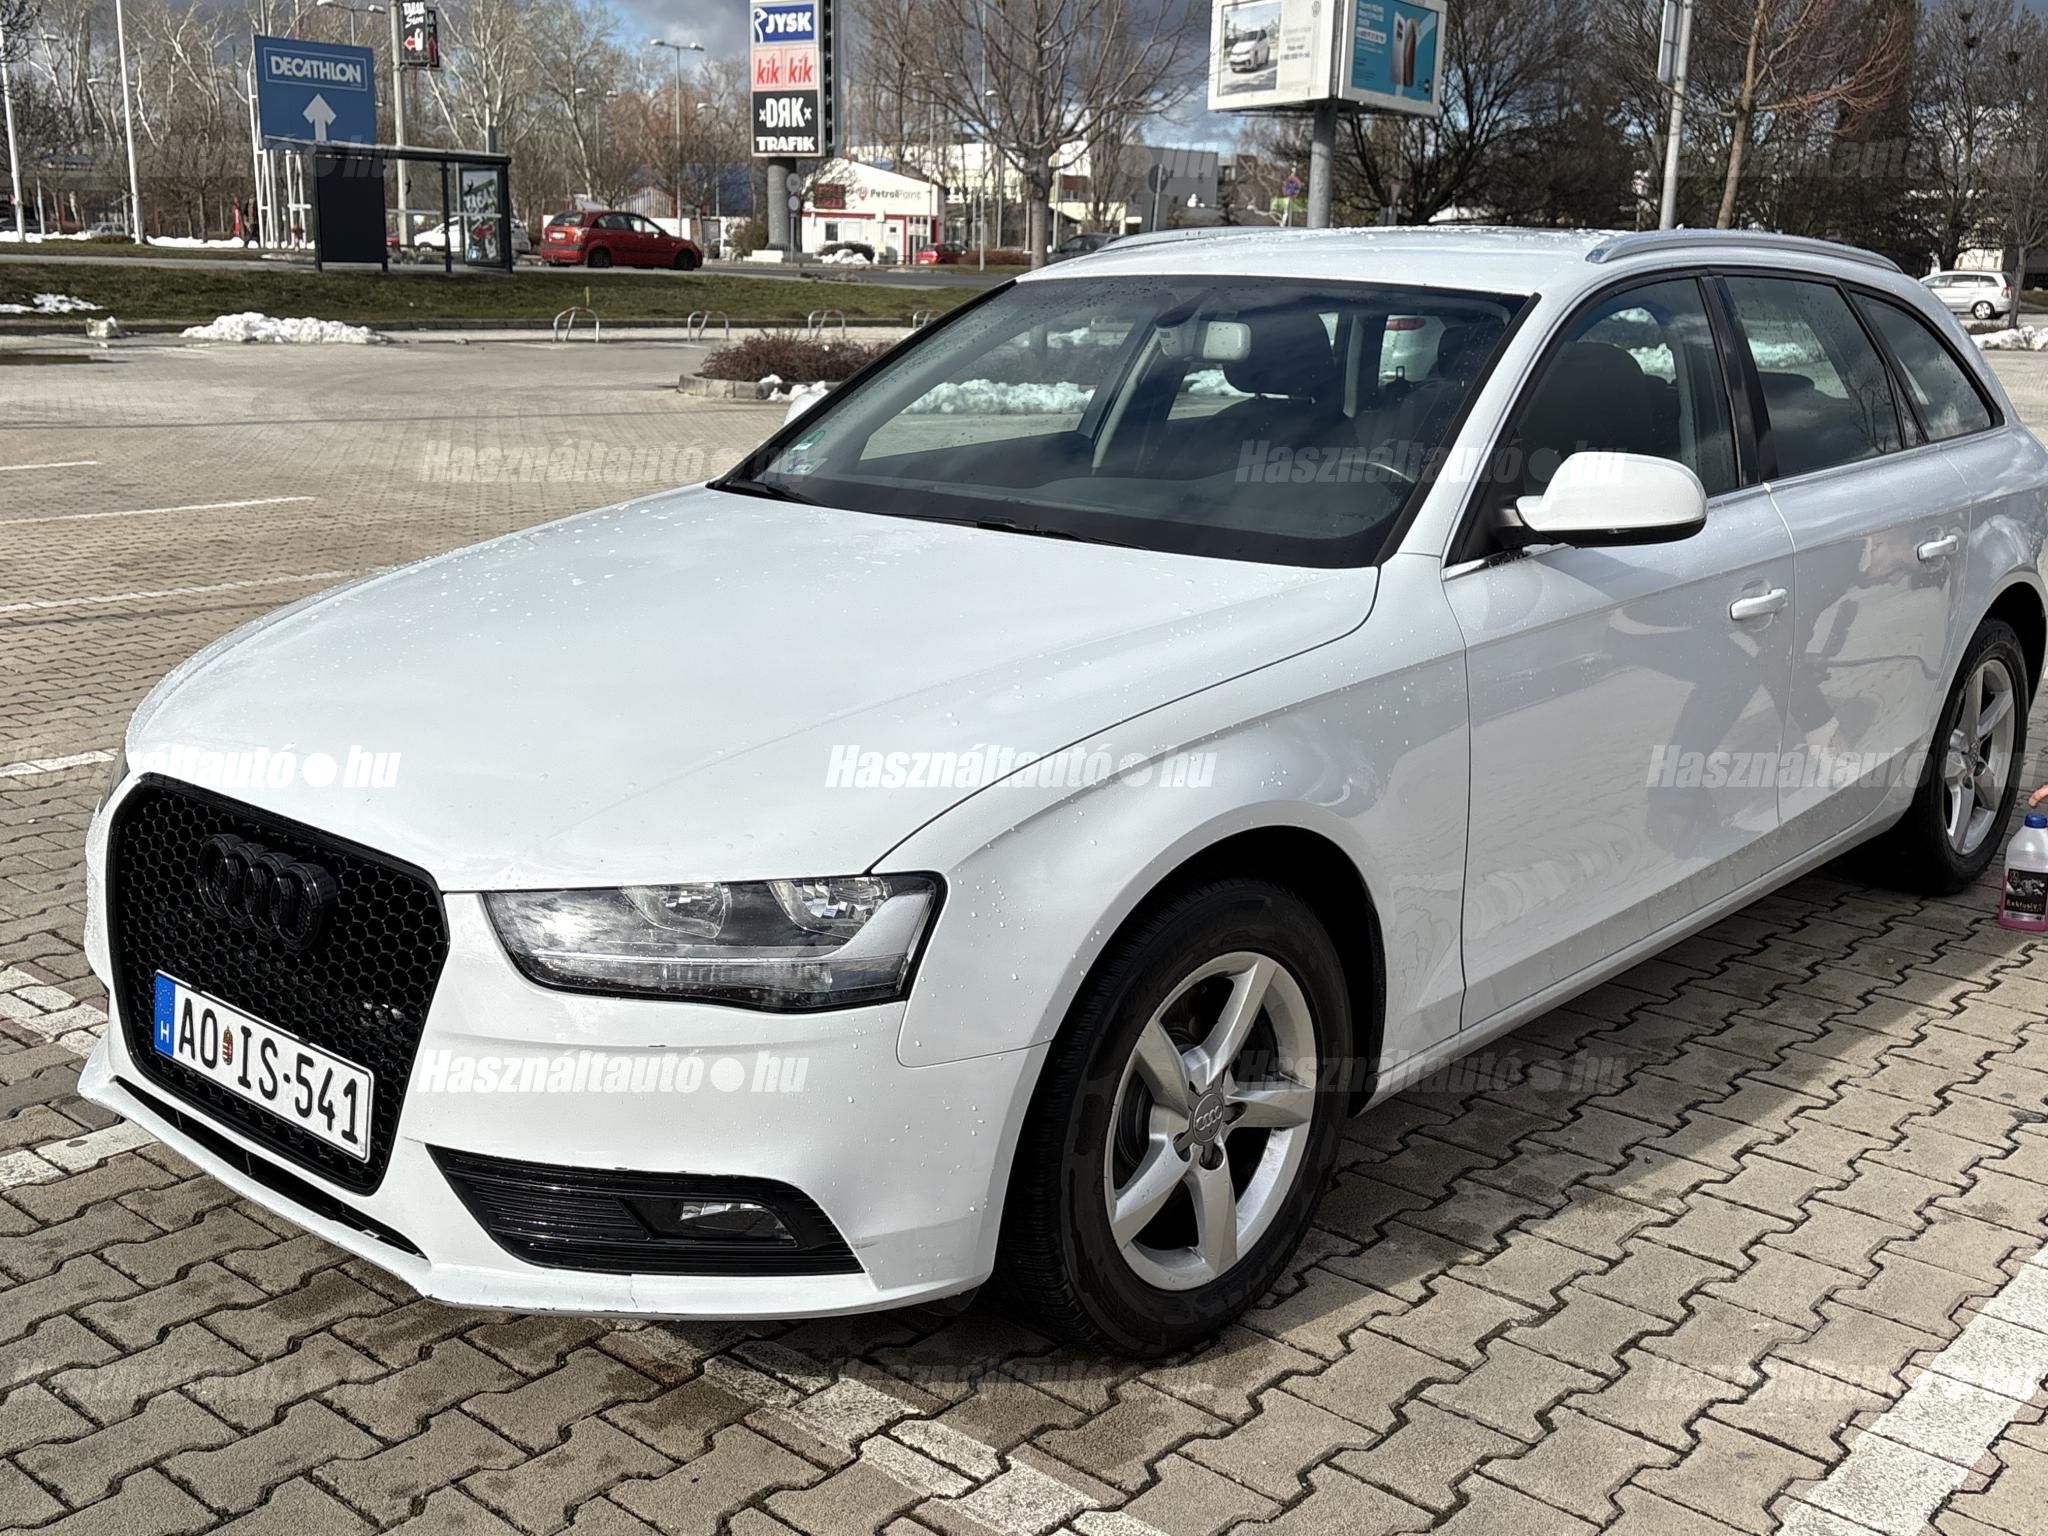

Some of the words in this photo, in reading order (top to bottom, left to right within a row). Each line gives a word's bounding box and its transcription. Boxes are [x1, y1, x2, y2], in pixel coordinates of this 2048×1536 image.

[765, 11, 812, 33] JYSK
[270, 55, 362, 83] DECATHLON
[756, 136, 815, 152] TRAFIK
[160, 1020, 170, 1044] H
[178, 997, 219, 1070] AO
